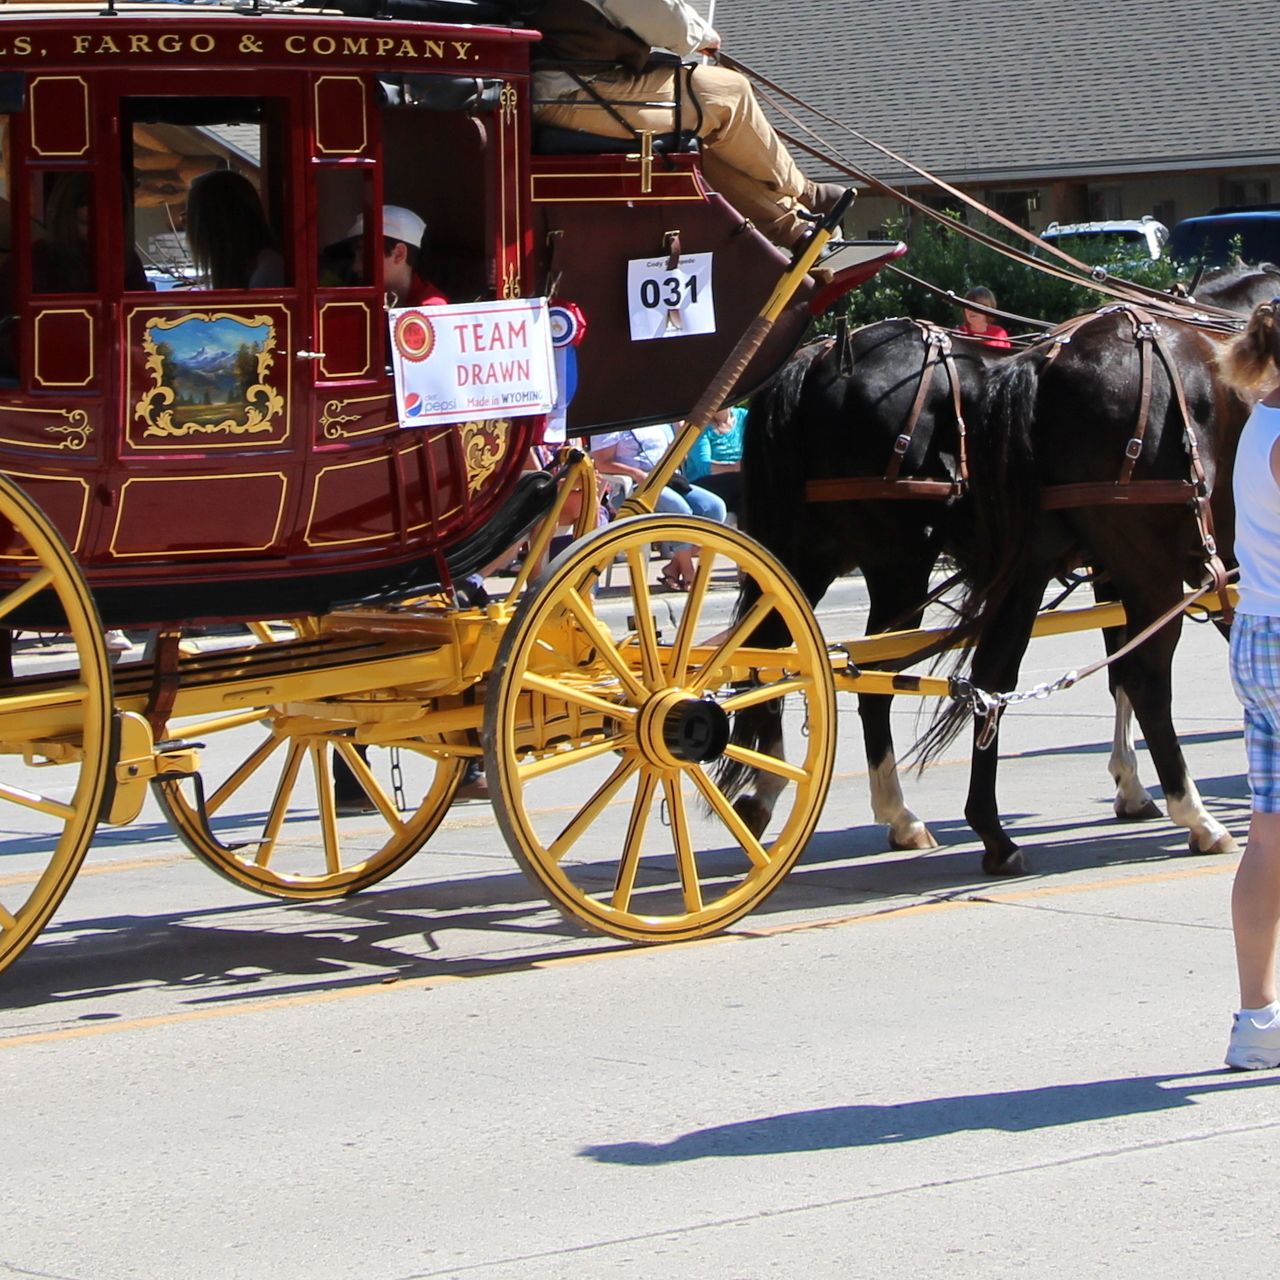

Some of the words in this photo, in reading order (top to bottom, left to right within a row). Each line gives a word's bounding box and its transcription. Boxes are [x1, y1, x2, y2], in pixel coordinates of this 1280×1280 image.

[73, 33, 217, 56] FARGO
[238, 33, 265, 55] &
[284, 33, 482, 61] COMPANY.
[640, 275, 698, 308] 031
[454, 320, 528, 353] TEAM
[456, 359, 530, 387] DRAWN
[424, 399, 456, 413] pepsi
[467, 397, 489, 407] Made
[492, 395, 500, 405] in
